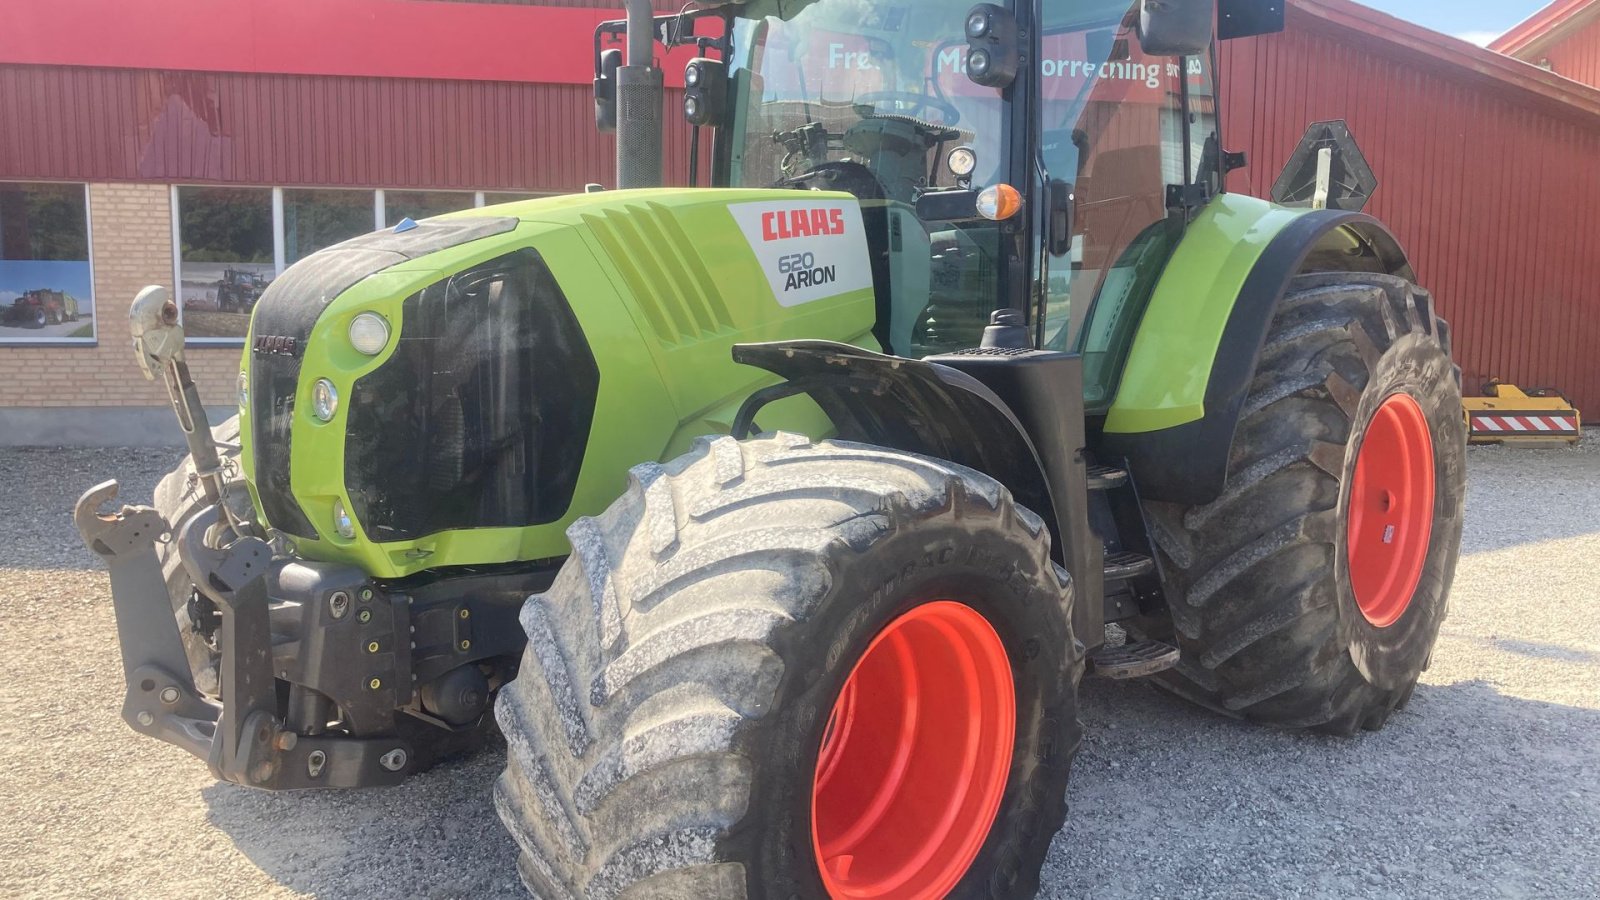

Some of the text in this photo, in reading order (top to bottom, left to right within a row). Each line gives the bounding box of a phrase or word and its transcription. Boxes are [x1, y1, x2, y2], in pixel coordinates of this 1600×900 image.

[762, 208, 845, 241] CLAAS
[778, 252, 815, 274] 620
[784, 265, 836, 291] ARION
